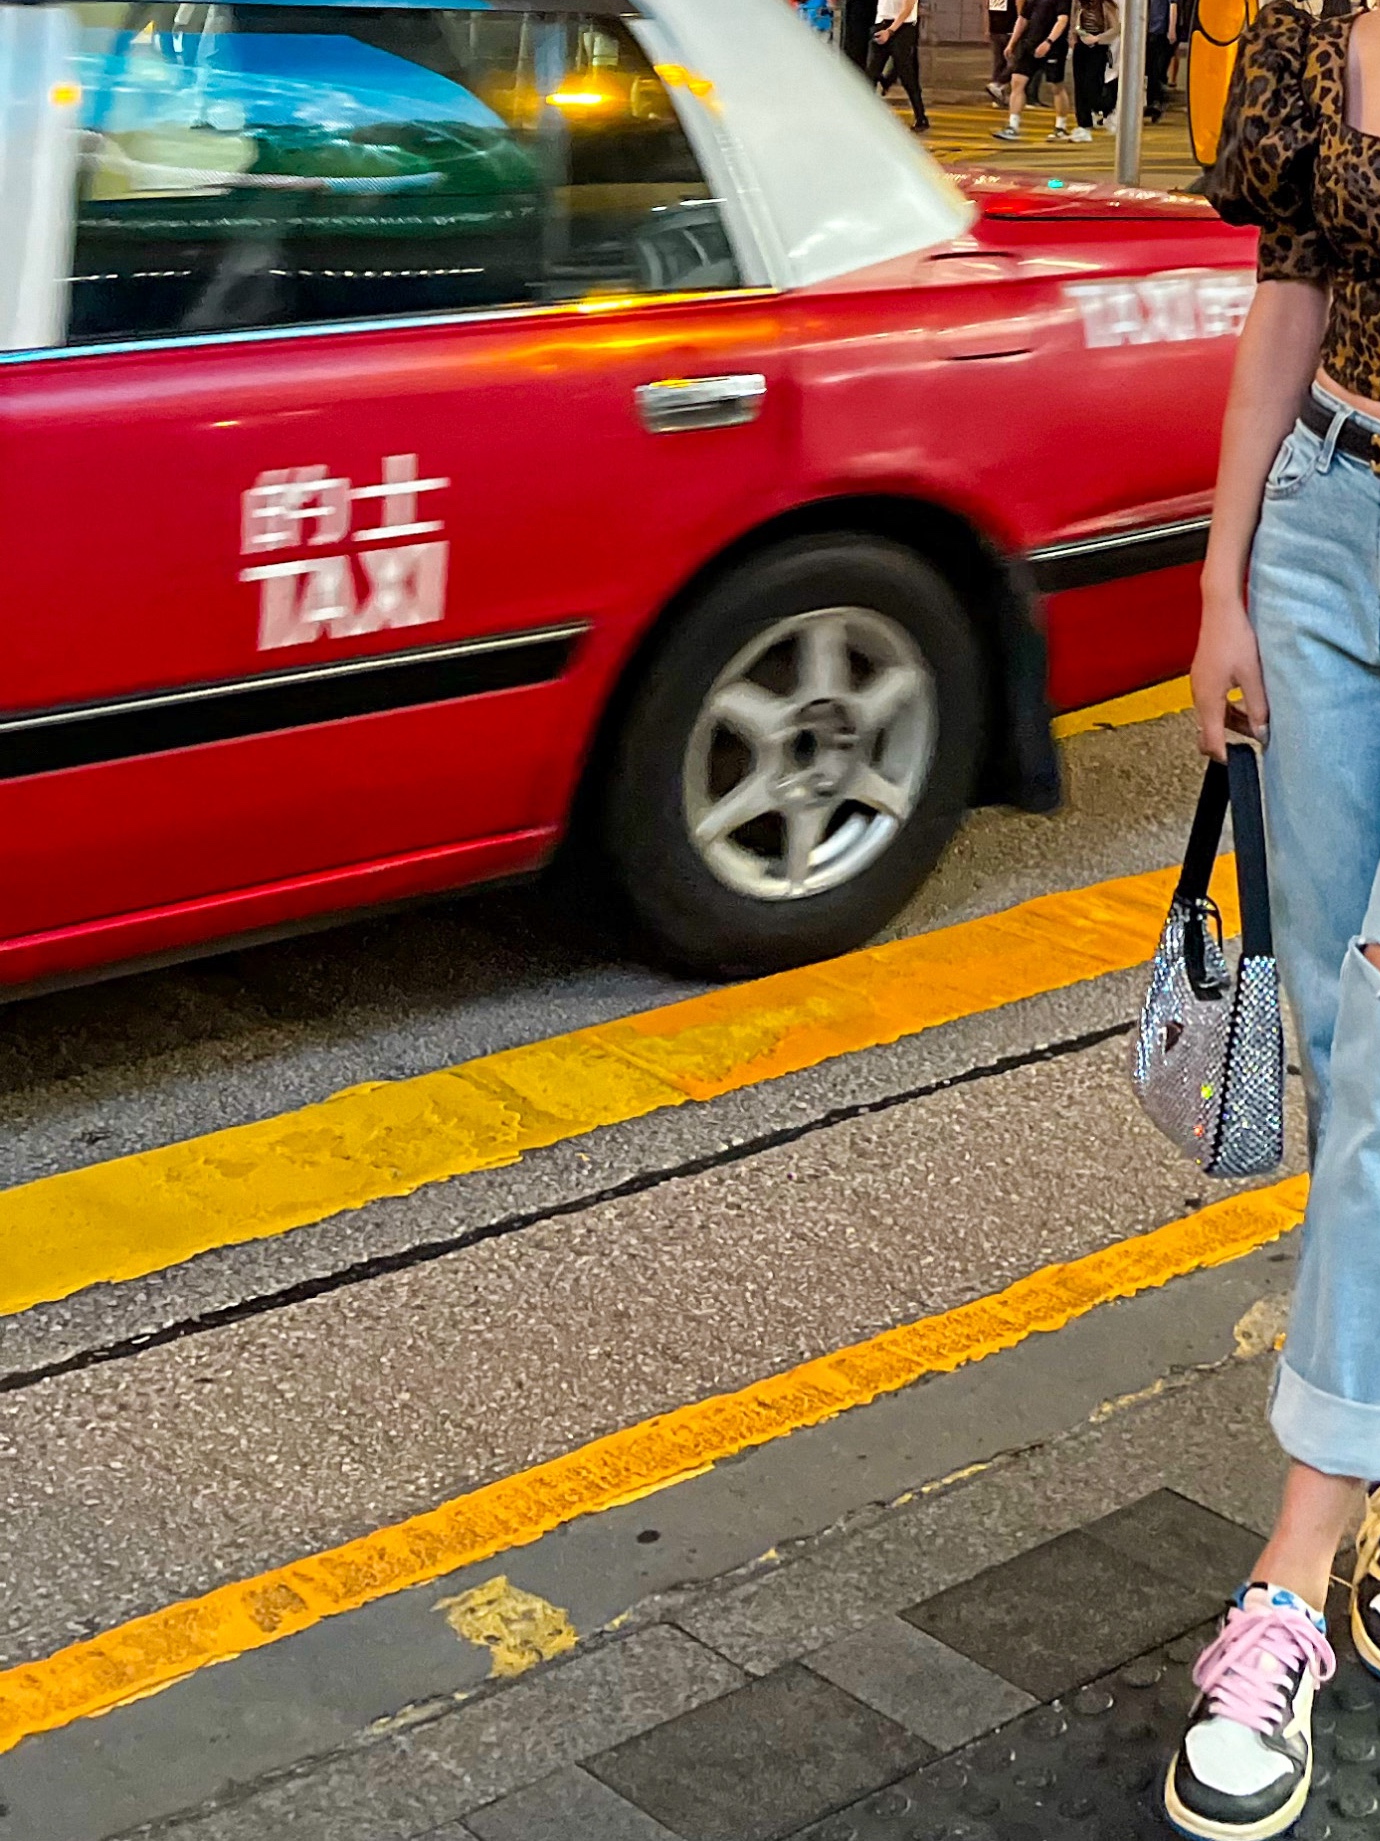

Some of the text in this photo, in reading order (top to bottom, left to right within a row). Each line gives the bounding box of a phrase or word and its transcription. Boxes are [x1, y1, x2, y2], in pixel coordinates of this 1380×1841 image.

[1062, 280, 1196, 348] TAXI
[239, 452, 451, 555] 的士
[237, 540, 451, 652] TAXI
